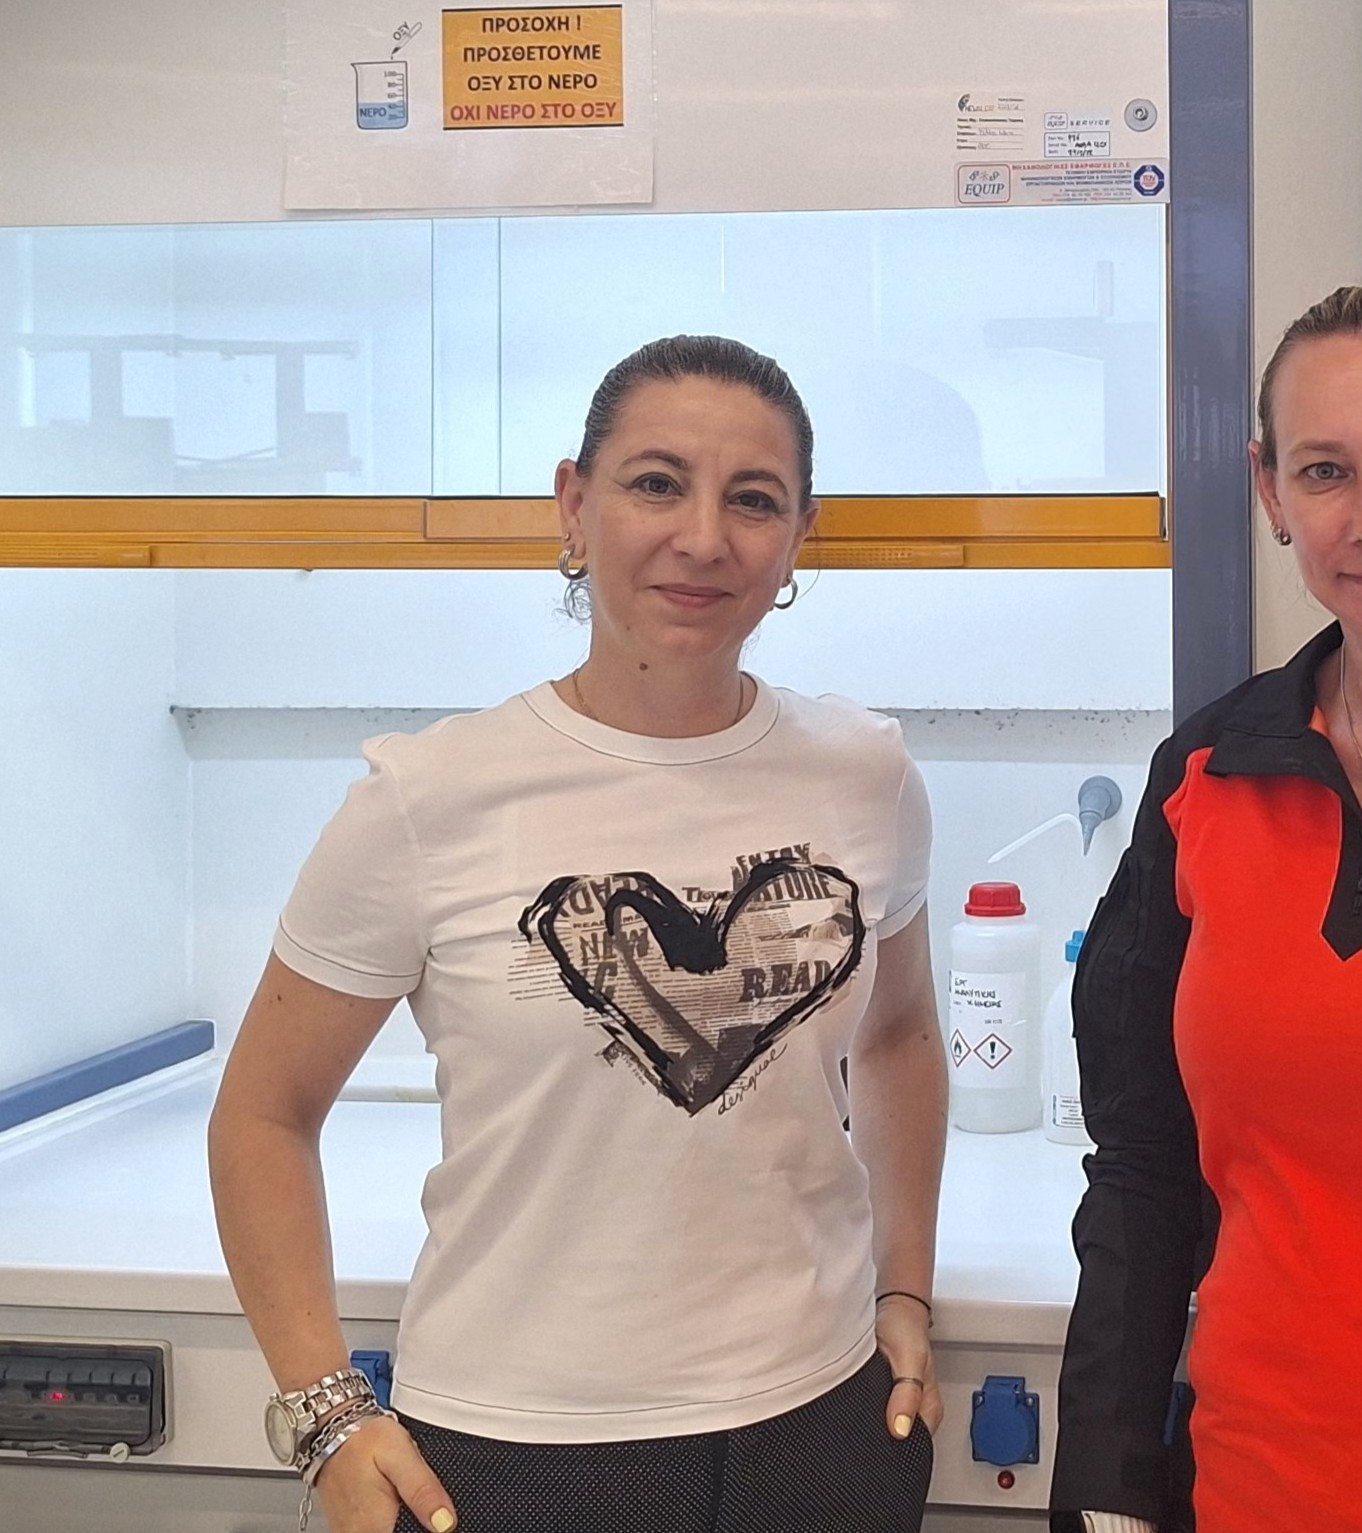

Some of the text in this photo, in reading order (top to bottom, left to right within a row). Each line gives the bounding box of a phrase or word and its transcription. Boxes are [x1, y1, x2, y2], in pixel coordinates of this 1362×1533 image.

[482, 16, 570, 33] ΠΡΟΣΟΧΗ
[463, 44, 601, 62] ΠΡΟΣΘΕΤΟΥΜΕ
[467, 74, 597, 91] ΟΞΥ ΣΤΟ ΝΕΡΟ
[360, 107, 387, 117] ΝΕΡΟ
[451, 102, 616, 121] ΟΧΙ ΝΕΡΟ ΣΤΟ ΟΞΥ
[964, 183, 1005, 197] EQUIP
